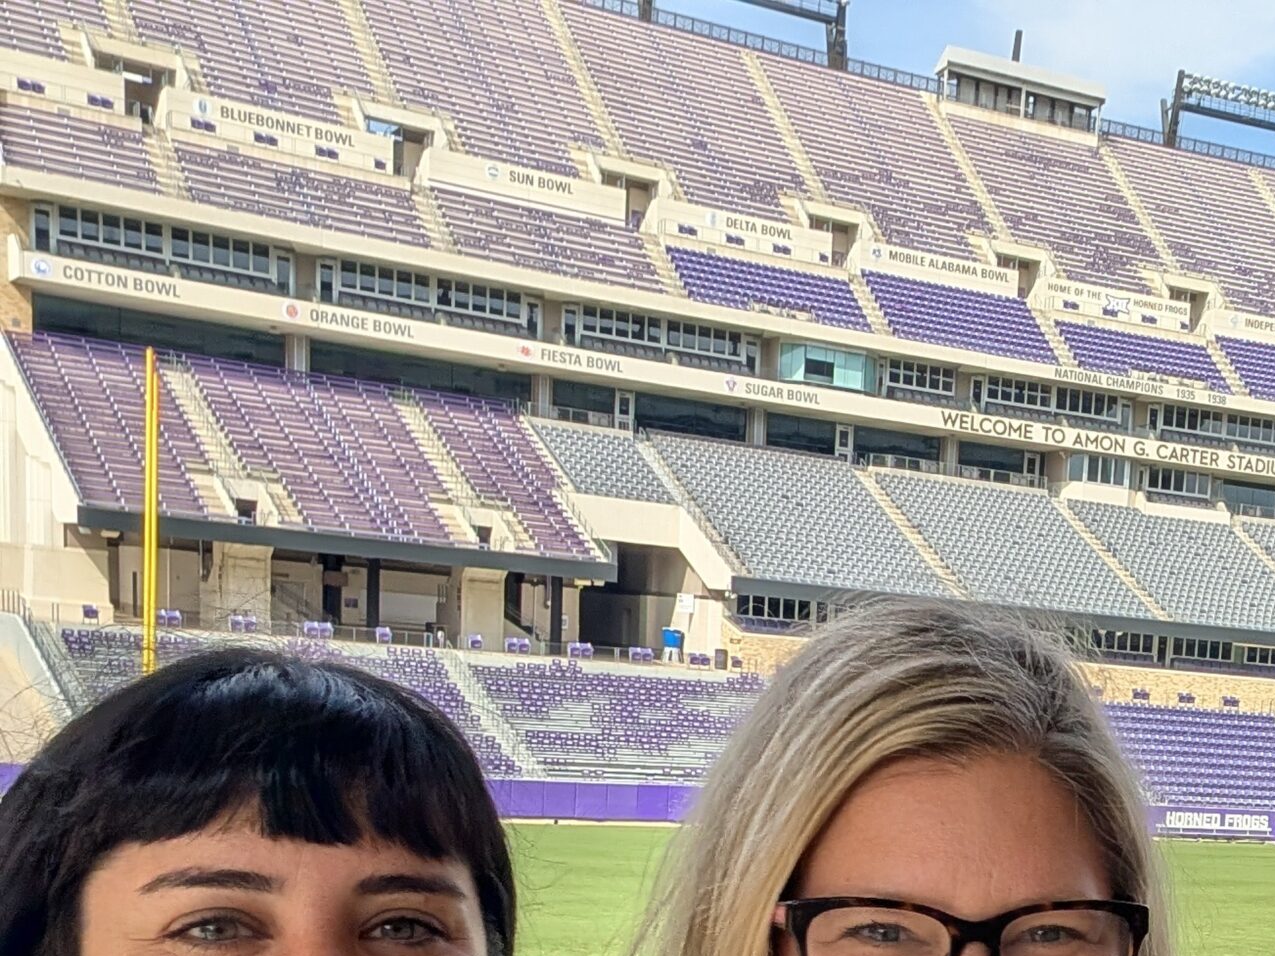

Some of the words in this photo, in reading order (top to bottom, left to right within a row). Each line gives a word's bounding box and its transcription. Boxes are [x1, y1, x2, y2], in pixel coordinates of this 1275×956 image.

[220, 105, 312, 138] BLUEBONNET
[314, 127, 355, 147] BOWL
[509, 170, 534, 186] SUN
[537, 176, 573, 195] BOWL
[726, 217, 758, 234] DELTA
[761, 224, 793, 240] BOWL
[888, 249, 926, 267] MOBILE
[928, 257, 978, 277] ALABAMA
[981, 268, 1010, 283] BOWL
[63, 265, 128, 289] COTTON
[133, 277, 181, 298] BOWL
[1048, 282, 1071, 295] HOME
[1074, 286, 1085, 297] OF
[1087, 288, 1102, 300] THE
[1133, 298, 1163, 312] HORNED
[1164, 305, 1188, 316] FROGS
[310, 308, 368, 331] ORANGE
[373, 319, 414, 339] BOWL
[541, 348, 582, 366] FIESTA
[586, 355, 623, 373] BOWL
[745, 382, 784, 399] SUGAR
[787, 389, 821, 405] BOWL
[1054, 367, 1104, 386] NATIONAL
[1106, 375, 1164, 396] CHAMPIONS
[1176, 388, 1196, 400] 1935
[1207, 393, 1227, 406] 1938
[941, 410, 1034, 440] WELCOME
[1041, 426, 1066, 444] TO
[1072, 431, 1126, 454] AMON
[1133, 440, 1150, 457] G.
[1156, 443, 1220, 467] CARTER
[1165, 810, 1222, 828] HORNED
[1224, 813, 1270, 829] FROGS
